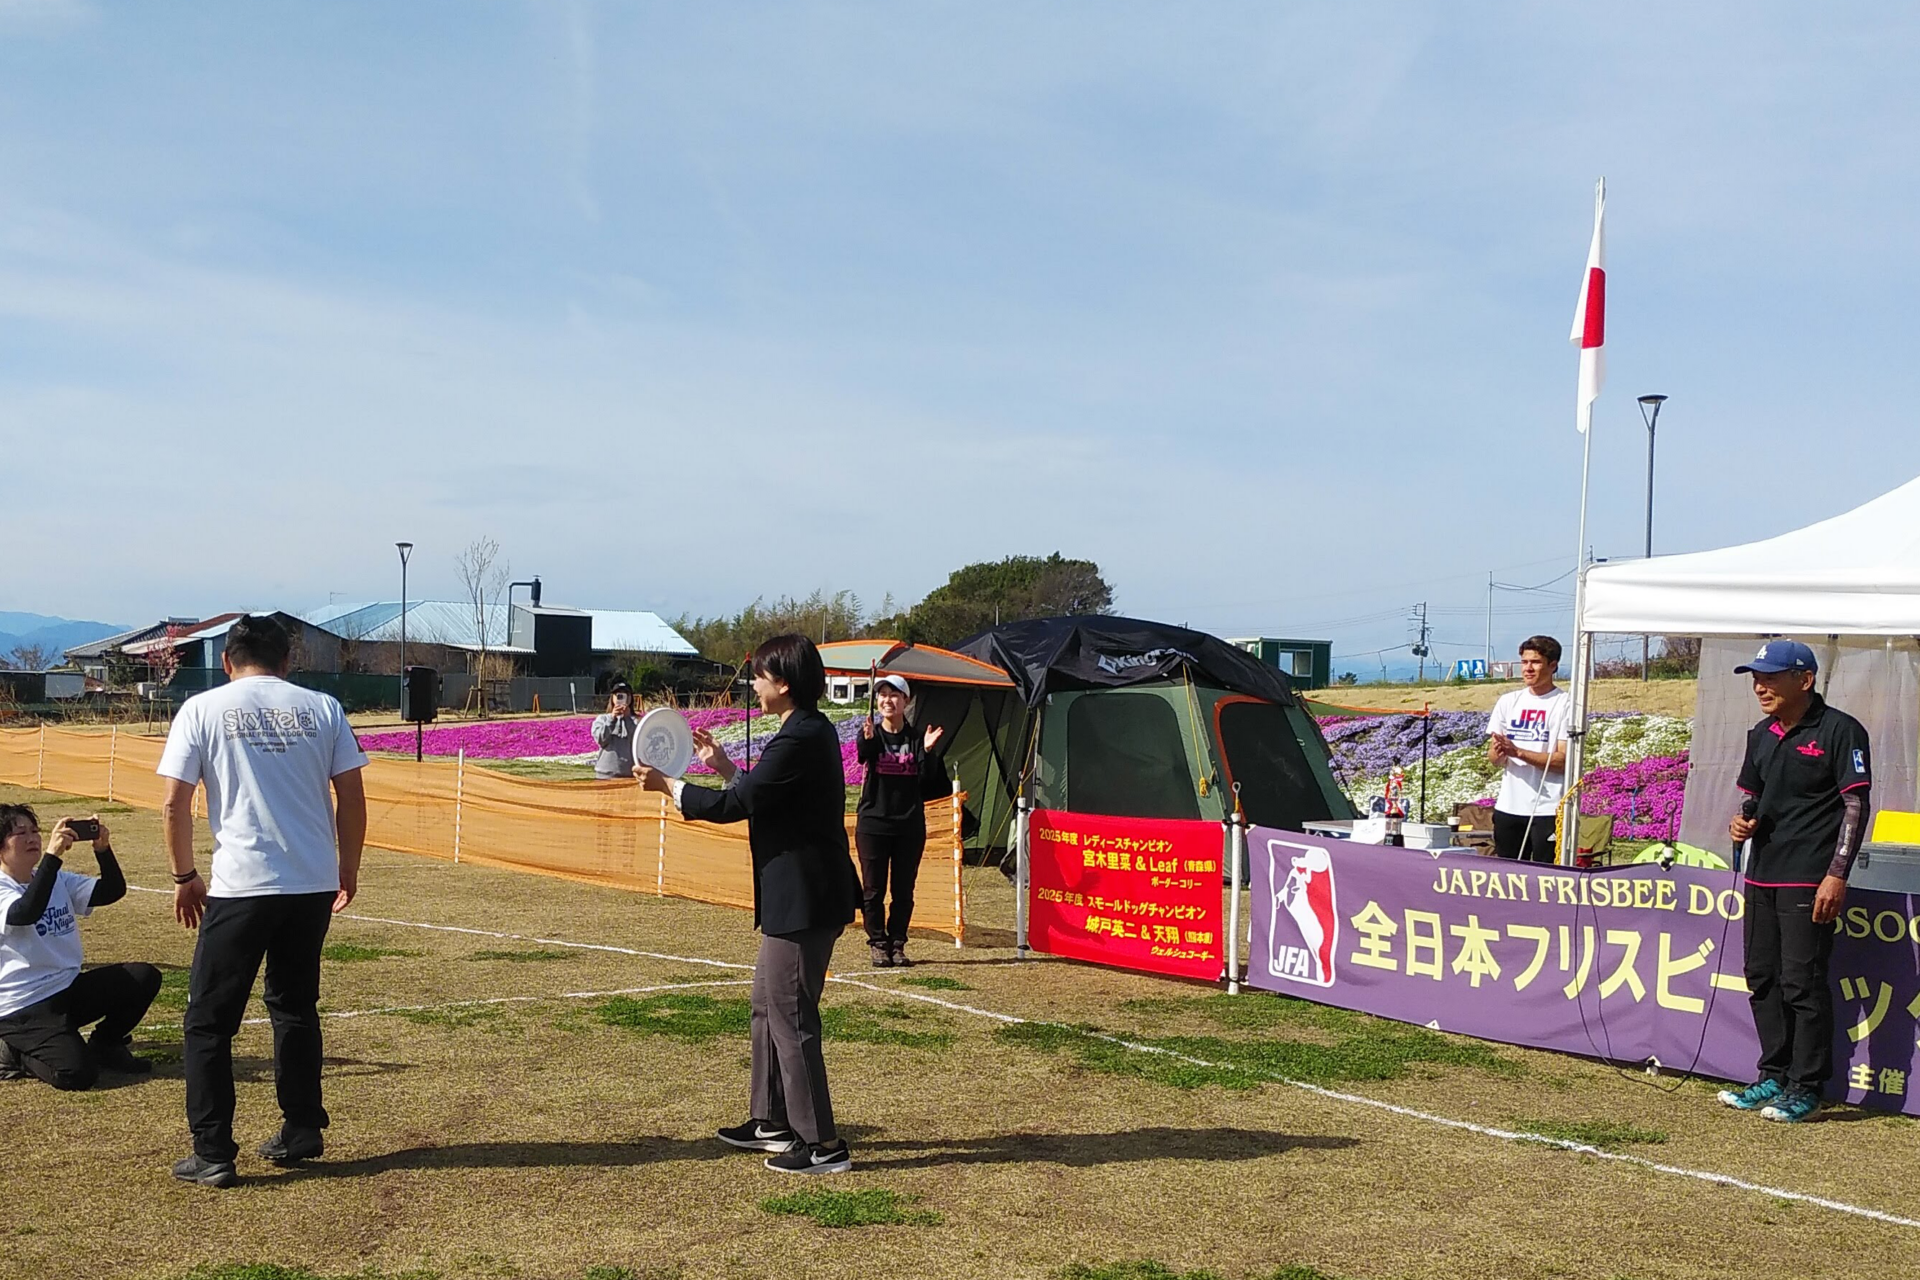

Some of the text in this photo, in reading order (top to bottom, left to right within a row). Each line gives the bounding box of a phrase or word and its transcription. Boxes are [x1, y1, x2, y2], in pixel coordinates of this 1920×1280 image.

[223, 706, 317, 732] SkyField
[1511, 709, 1546, 729] JFA
[1039, 827, 1173, 853] 2025年度 レディースチャンピオン
[1135, 856, 1147, 872] &
[1150, 857, 1178, 873] Leaf
[1432, 867, 1530, 901] JAPAN
[1537, 875, 1678, 911] FRISBEE
[1087, 895, 1207, 920] スモールドッグチャンピオン
[1141, 924, 1152, 940] &
[1273, 945, 1310, 978] JFA
[1849, 1063, 1906, 1096] 主催
